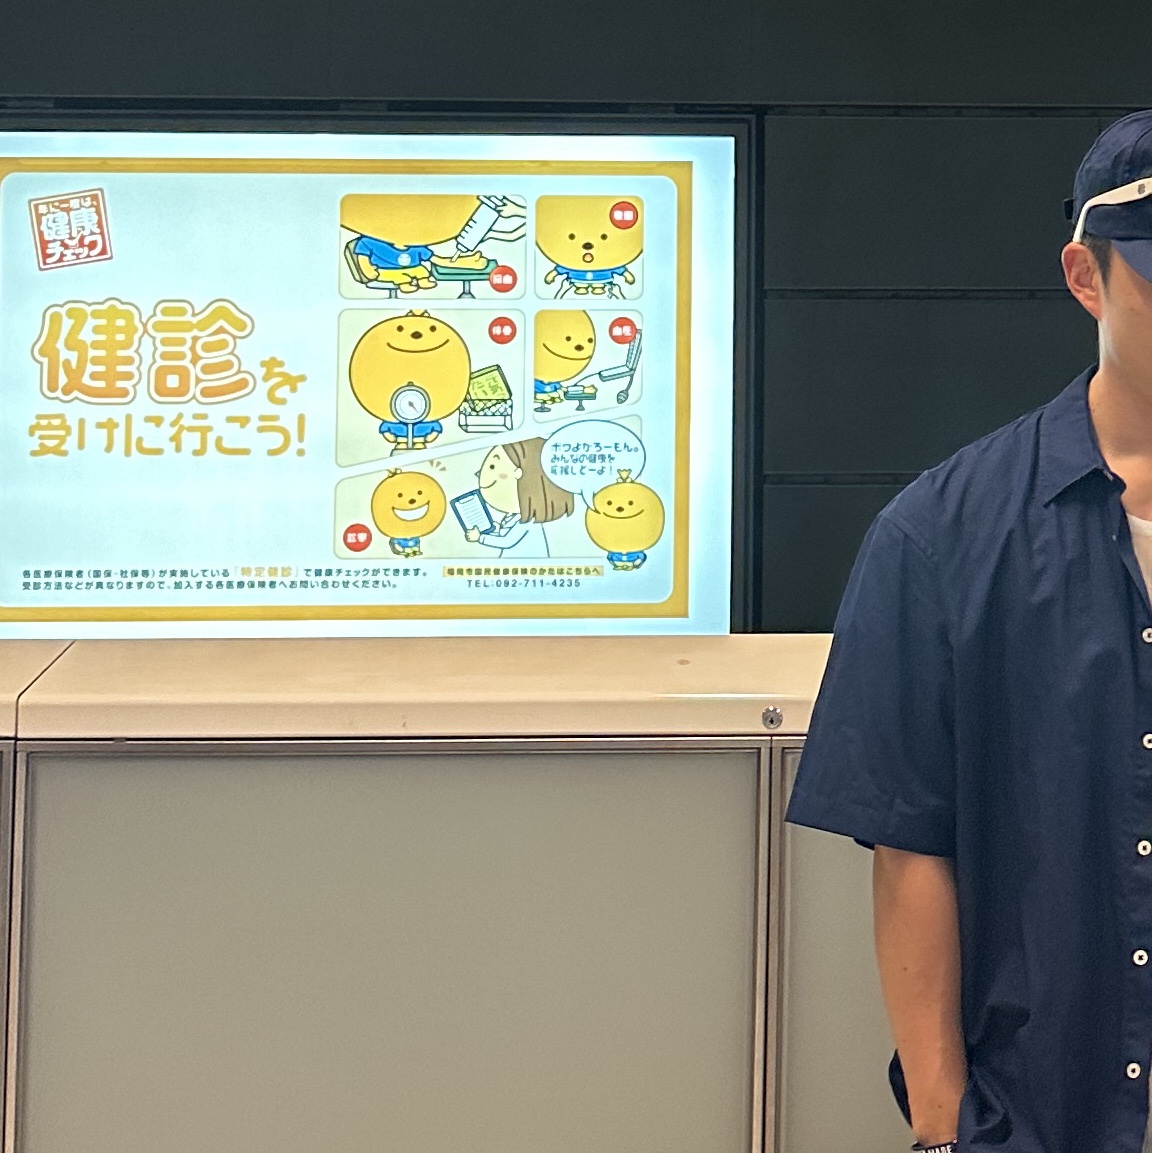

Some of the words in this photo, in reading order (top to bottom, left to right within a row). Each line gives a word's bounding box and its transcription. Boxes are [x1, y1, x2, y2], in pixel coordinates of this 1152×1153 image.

[40, 207, 100, 241] 健康
[46, 234, 103, 263] チェック
[33, 299, 307, 405] 健診を
[28, 413, 306, 458] 受けに行こう!
